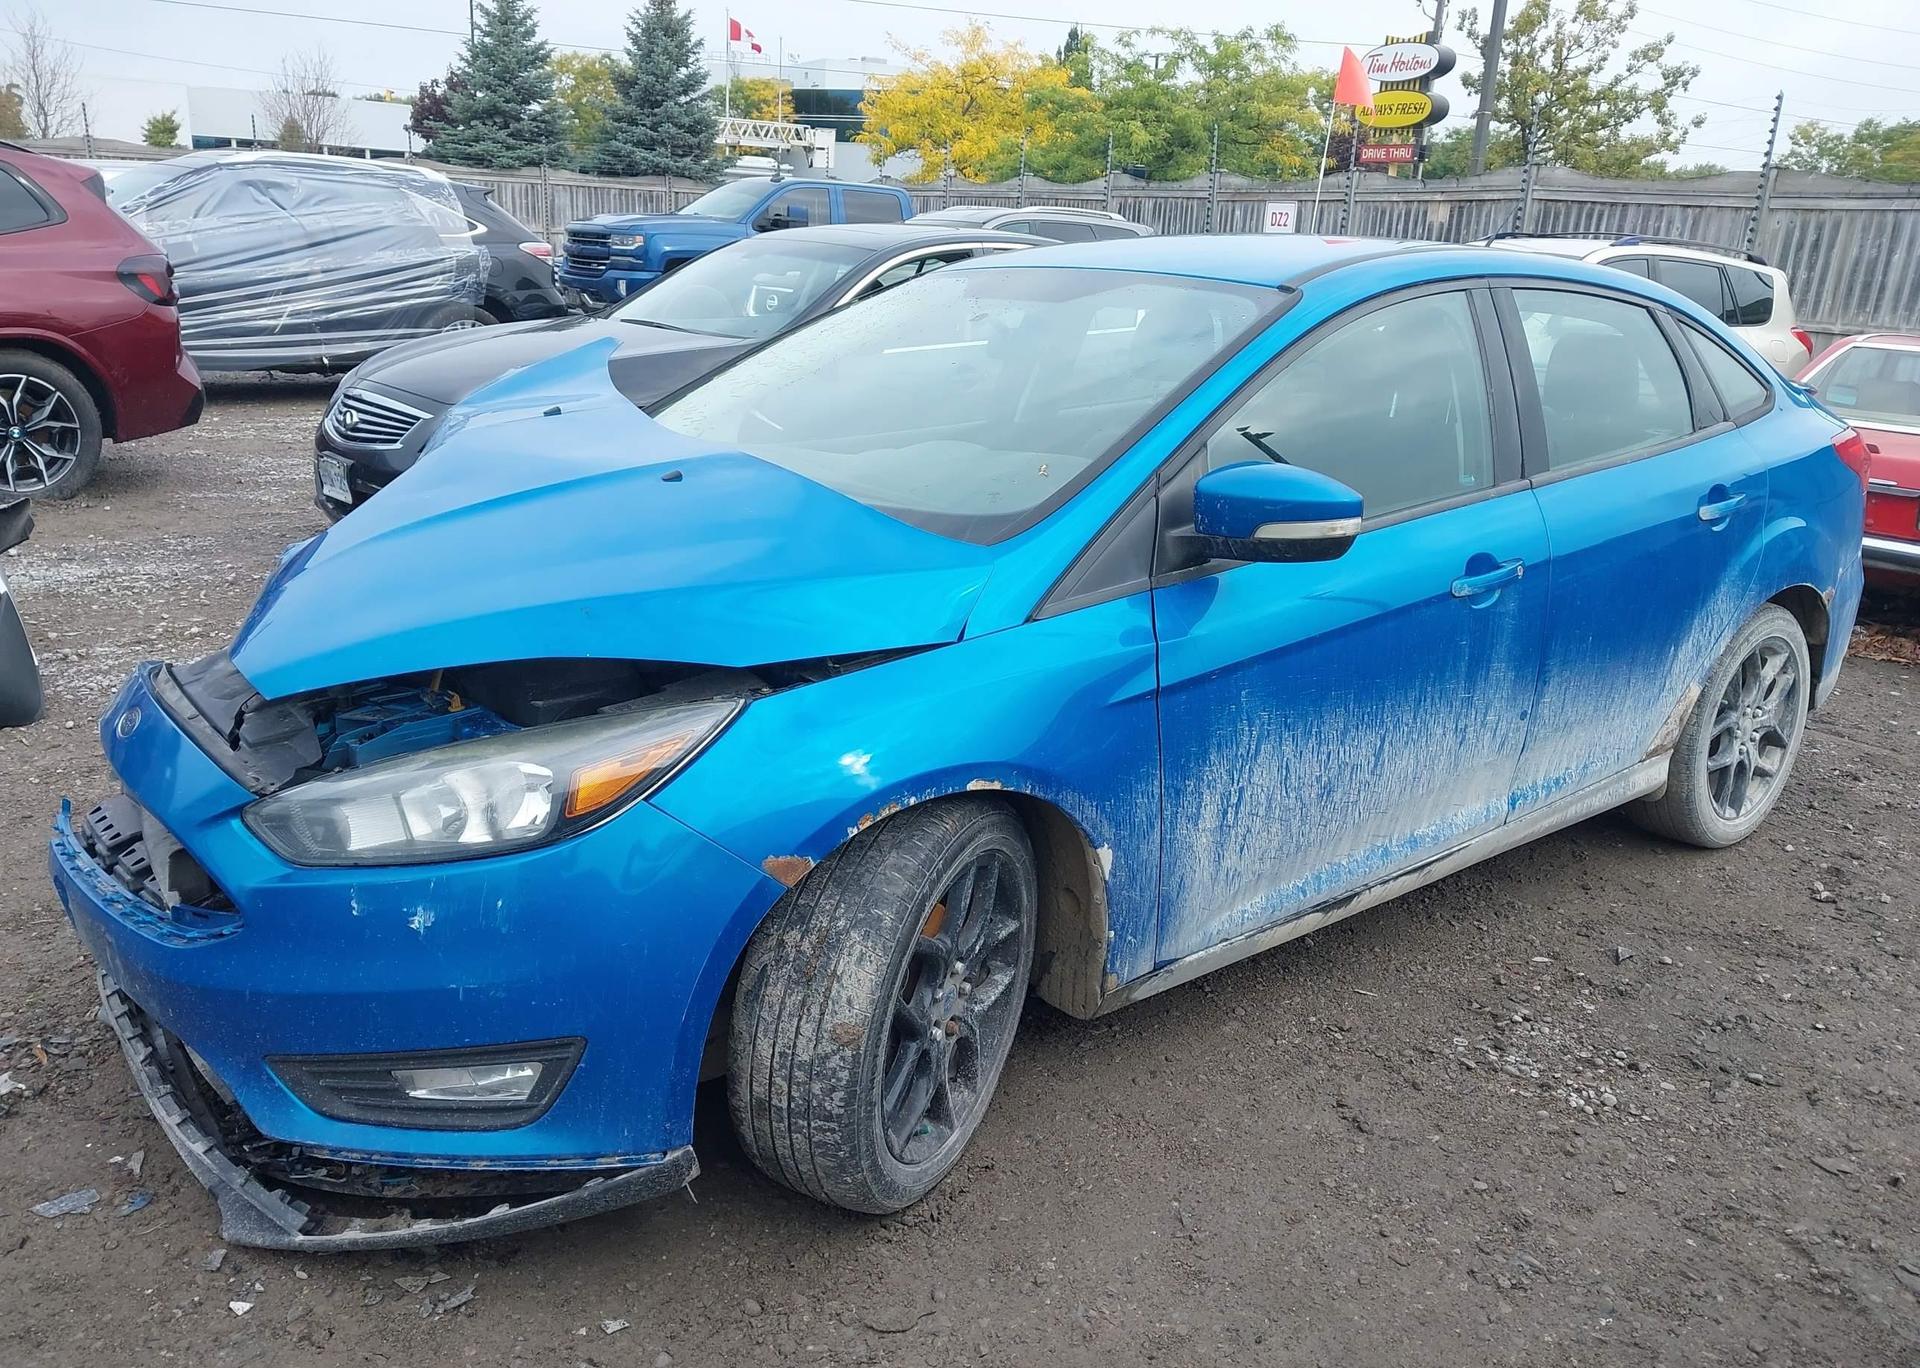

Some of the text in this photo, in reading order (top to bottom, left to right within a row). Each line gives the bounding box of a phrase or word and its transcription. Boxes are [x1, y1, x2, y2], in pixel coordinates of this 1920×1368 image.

[1367, 51, 1432, 75] Tim Hortons
[1394, 102, 1426, 115] FRESH
[1362, 147, 1412, 159] DRIVE THRU
[1270, 212, 1290, 227] DZ2
